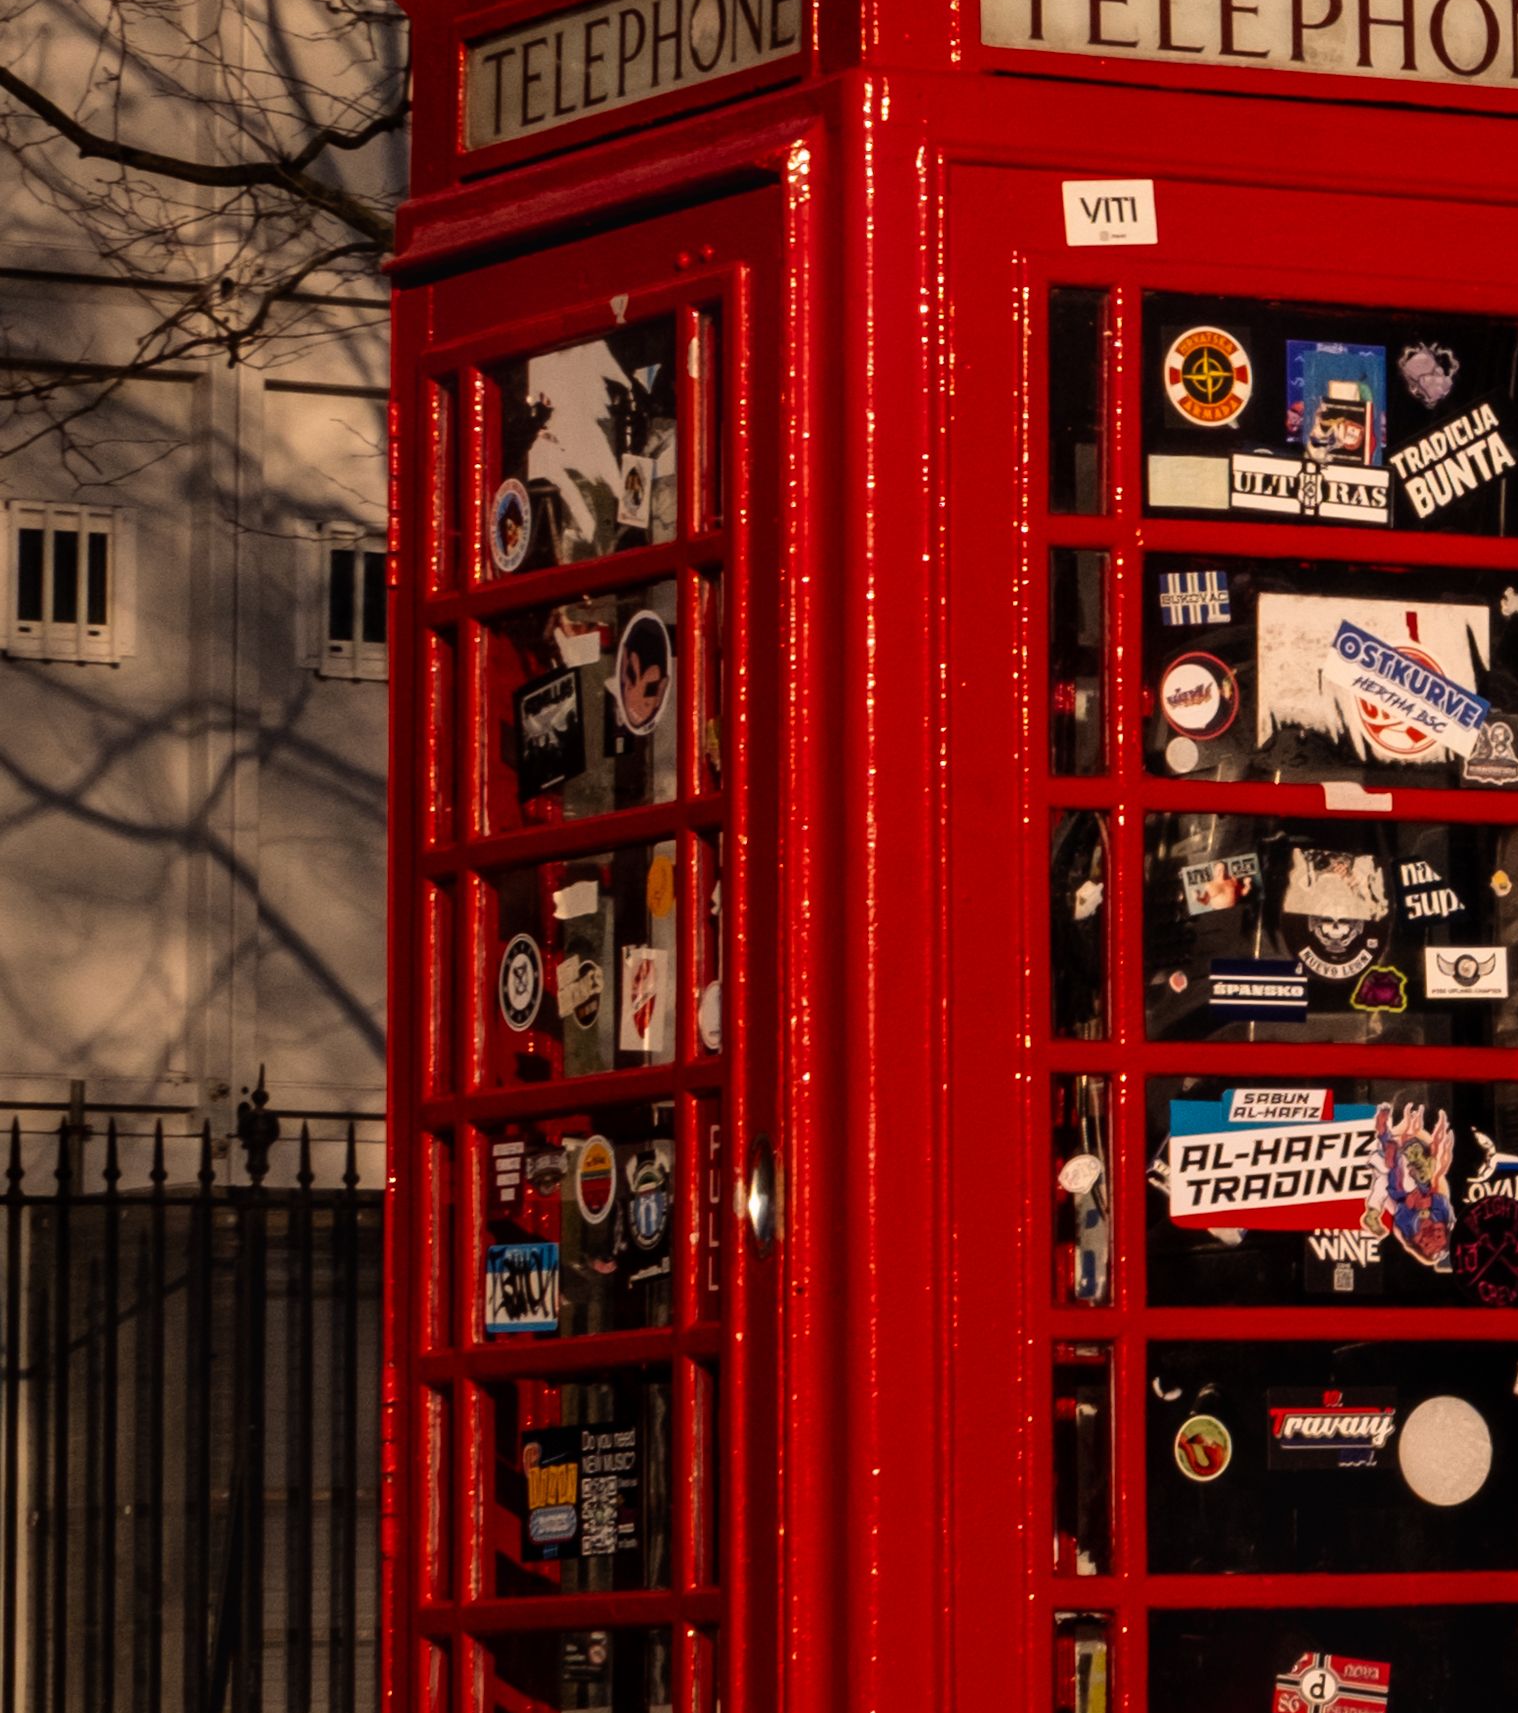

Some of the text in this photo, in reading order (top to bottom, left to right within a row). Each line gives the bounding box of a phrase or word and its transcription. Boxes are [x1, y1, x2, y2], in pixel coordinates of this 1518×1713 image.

[1079, 196, 1138, 224] VITI
[1180, 395, 1243, 421] ARMADA
[1389, 403, 1499, 479] TRADICIJA
[1405, 431, 1516, 519] BUNTA
[1338, 634, 1481, 729] OSTKURVE
[1352, 675, 1448, 734] HERTHA BSC
[1233, 1106, 1321, 1120] AL-HAFIZ
[1243, 1092, 1310, 1105] SABUN
[1179, 1130, 1376, 1173] AL-HAFIZ
[1187, 1164, 1373, 1207] TRADING
